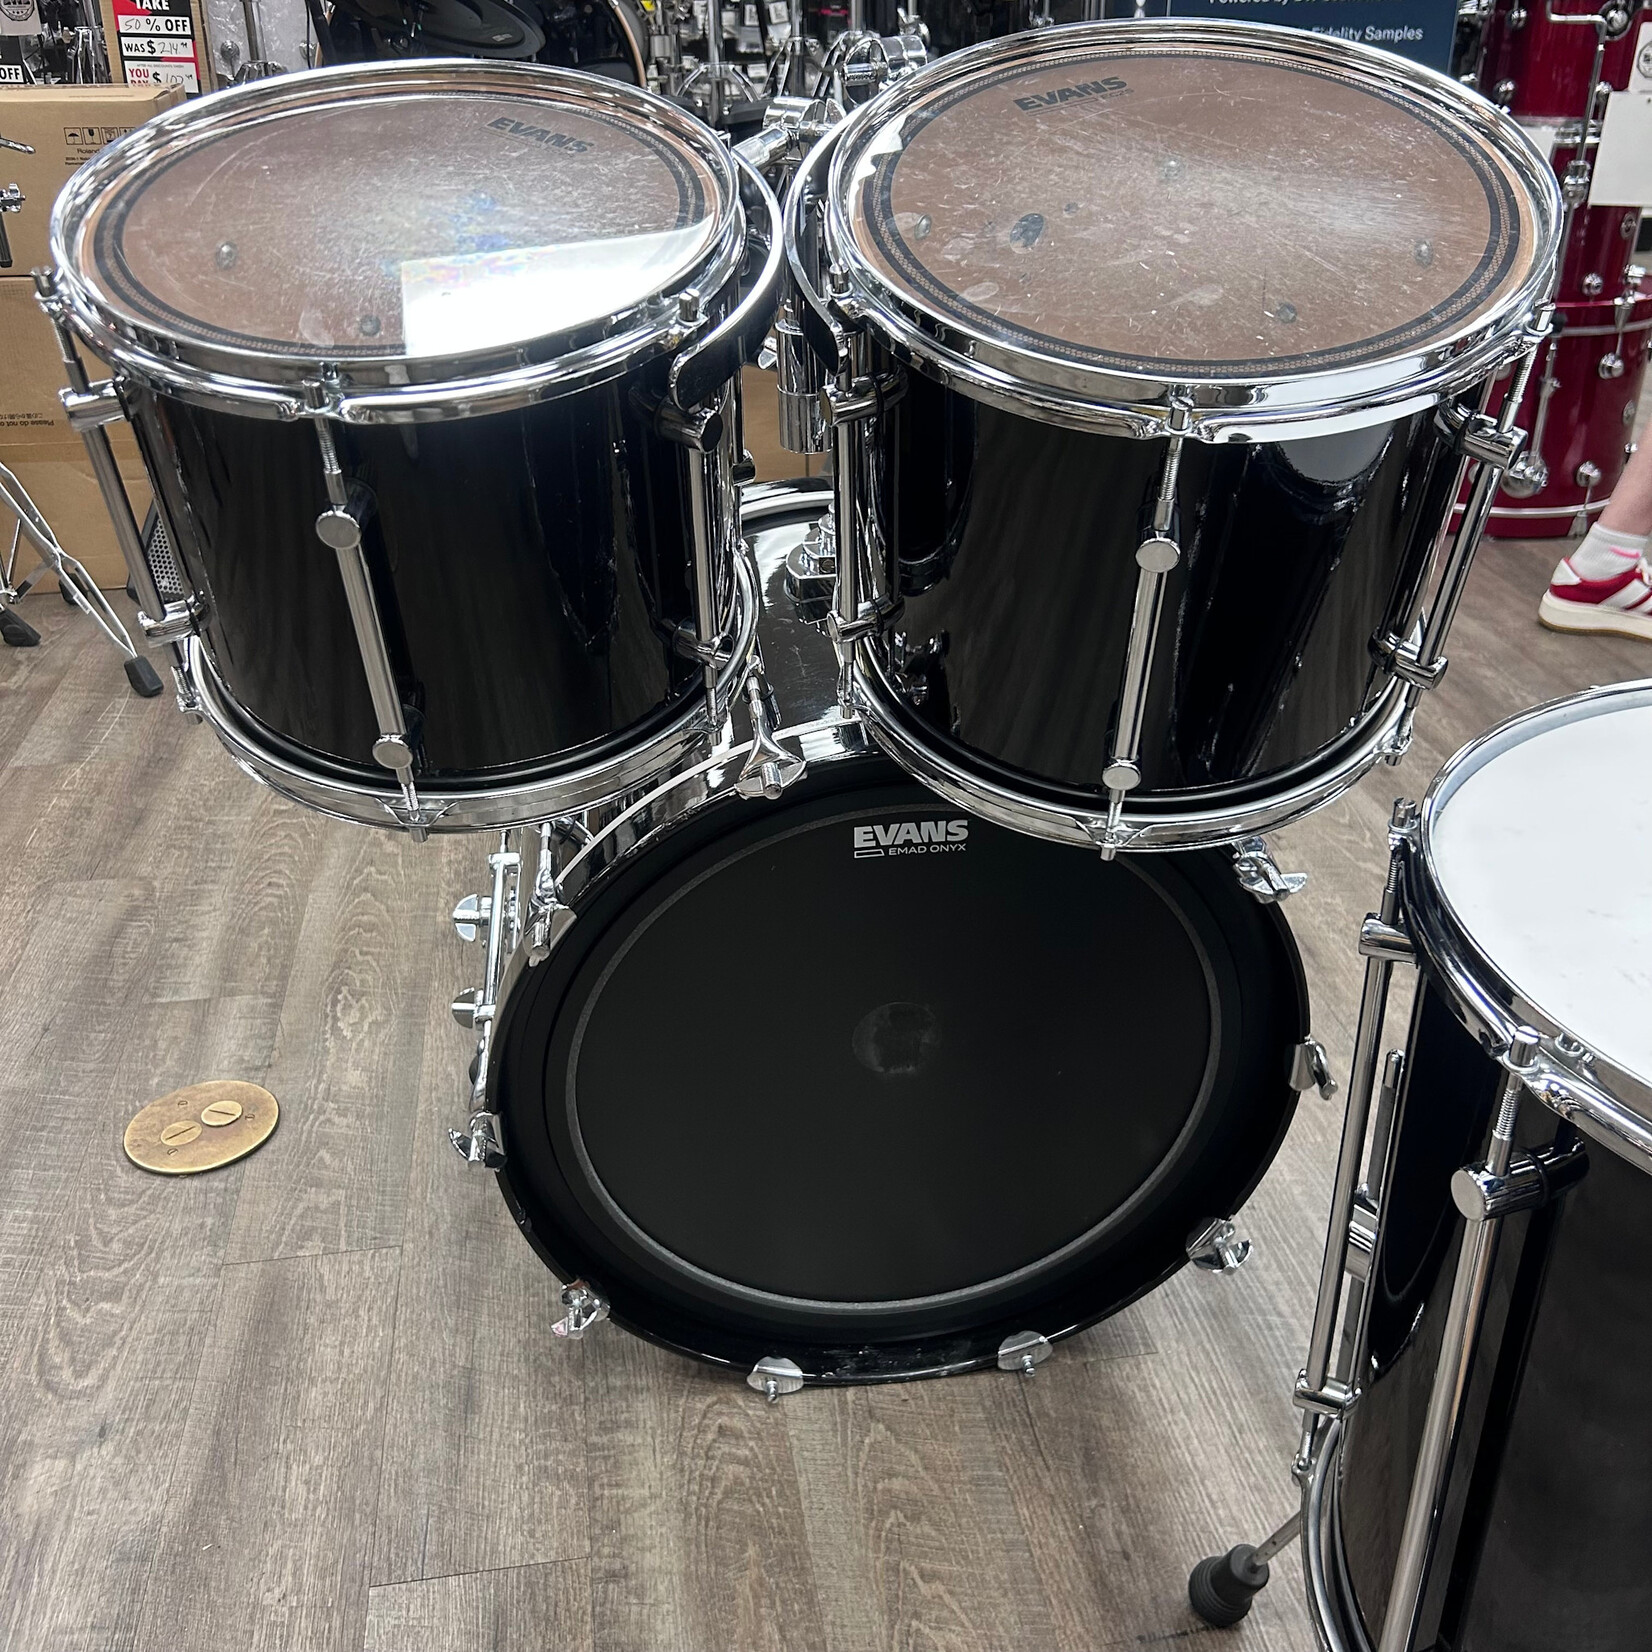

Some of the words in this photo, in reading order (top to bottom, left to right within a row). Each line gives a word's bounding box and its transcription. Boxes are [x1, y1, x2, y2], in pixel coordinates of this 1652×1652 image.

[135, 0, 170, 11] TAKE
[124, 18, 141, 31] 50
[164, 18, 188, 32] OFF
[1364, 25, 1424, 43] Samples
[124, 42, 146, 53] WAS
[0, 67, 20, 80] OFF
[129, 68, 150, 79] YOU
[1013, 76, 1127, 111] EVANS
[487, 117, 595, 152] EVANS
[854, 819, 969, 848] EVANS
[888, 846, 928, 856] EMAD
[929, 843, 967, 853] ONYX
